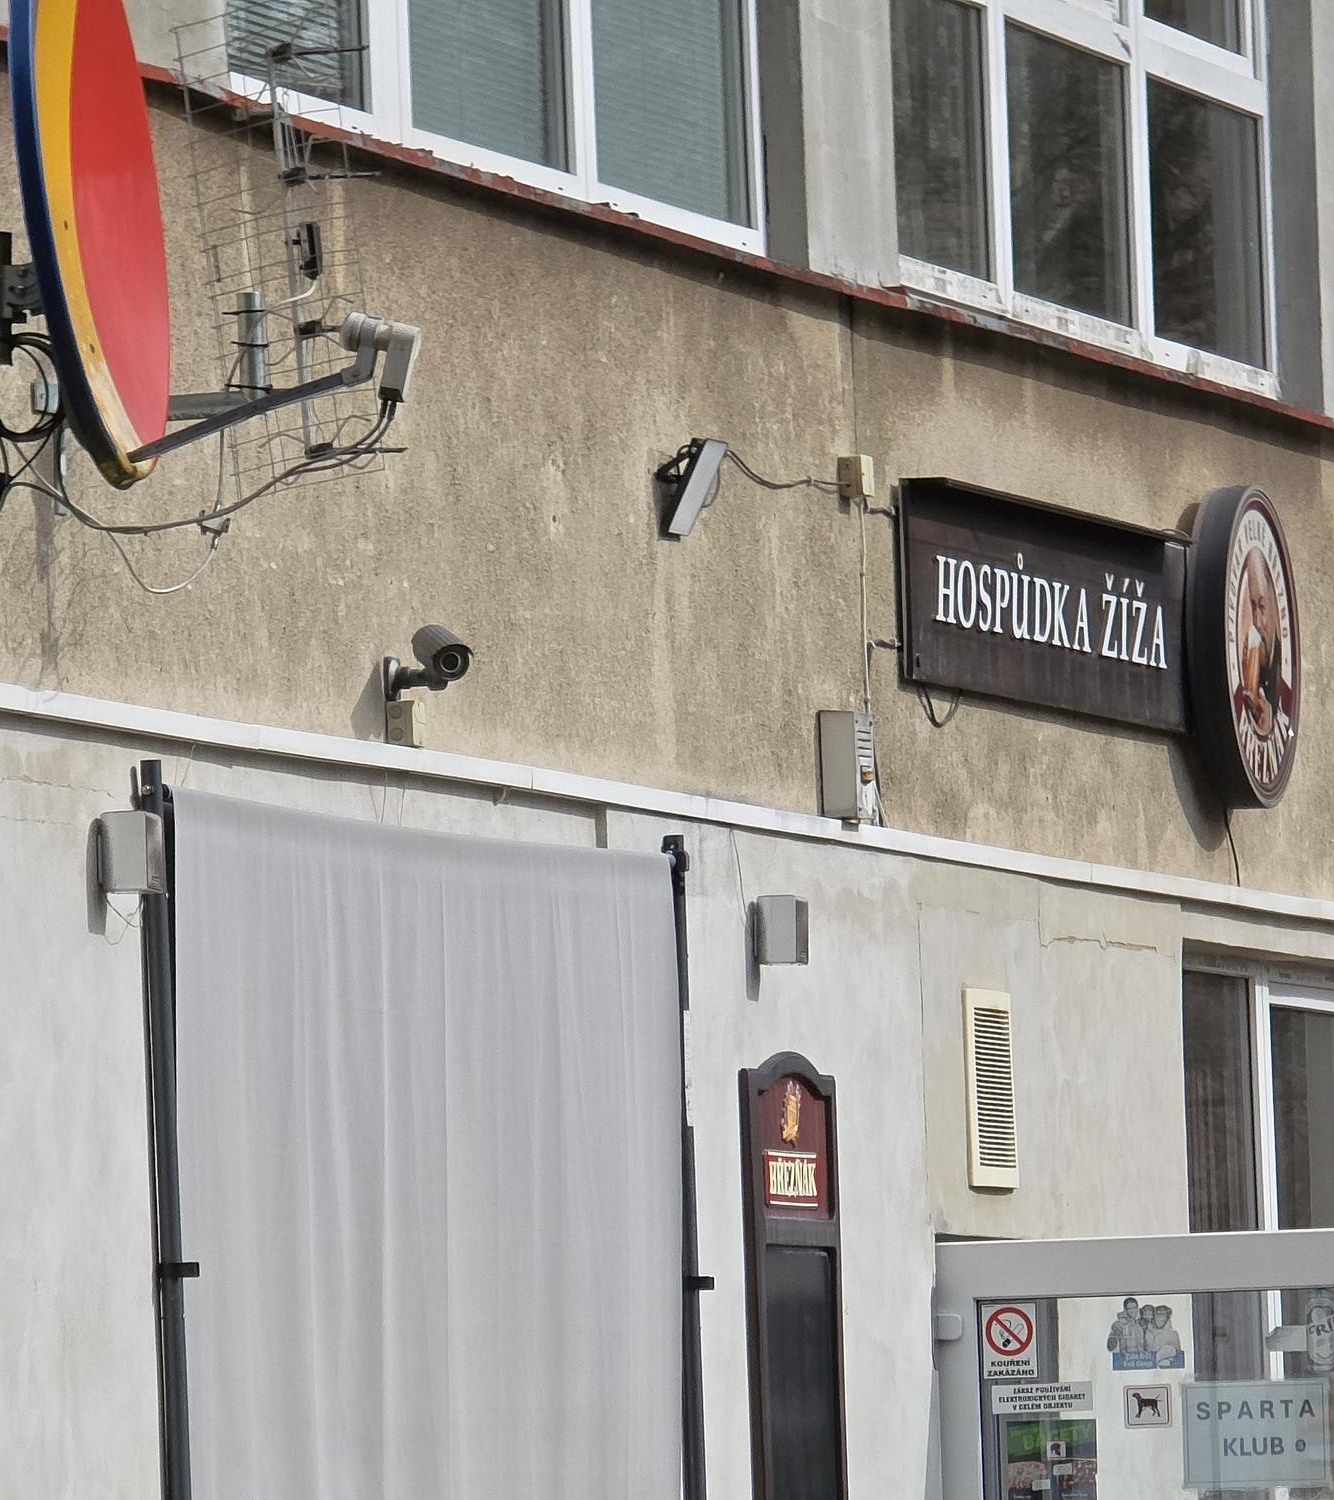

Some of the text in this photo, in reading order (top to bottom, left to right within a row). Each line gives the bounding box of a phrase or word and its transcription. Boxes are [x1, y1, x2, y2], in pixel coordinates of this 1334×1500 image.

[935, 552, 1168, 670] HOSPŮDKA ŽÍŽA
[990, 1358, 1031, 1368] KOUŘENÍ
[986, 1368, 1035, 1377] ZAKÁZÁNO
[1043, 1402, 1073, 1410] OBJEKTU
[1196, 1399, 1315, 1420] SPARTA
[1223, 1437, 1285, 1456] KLUB
